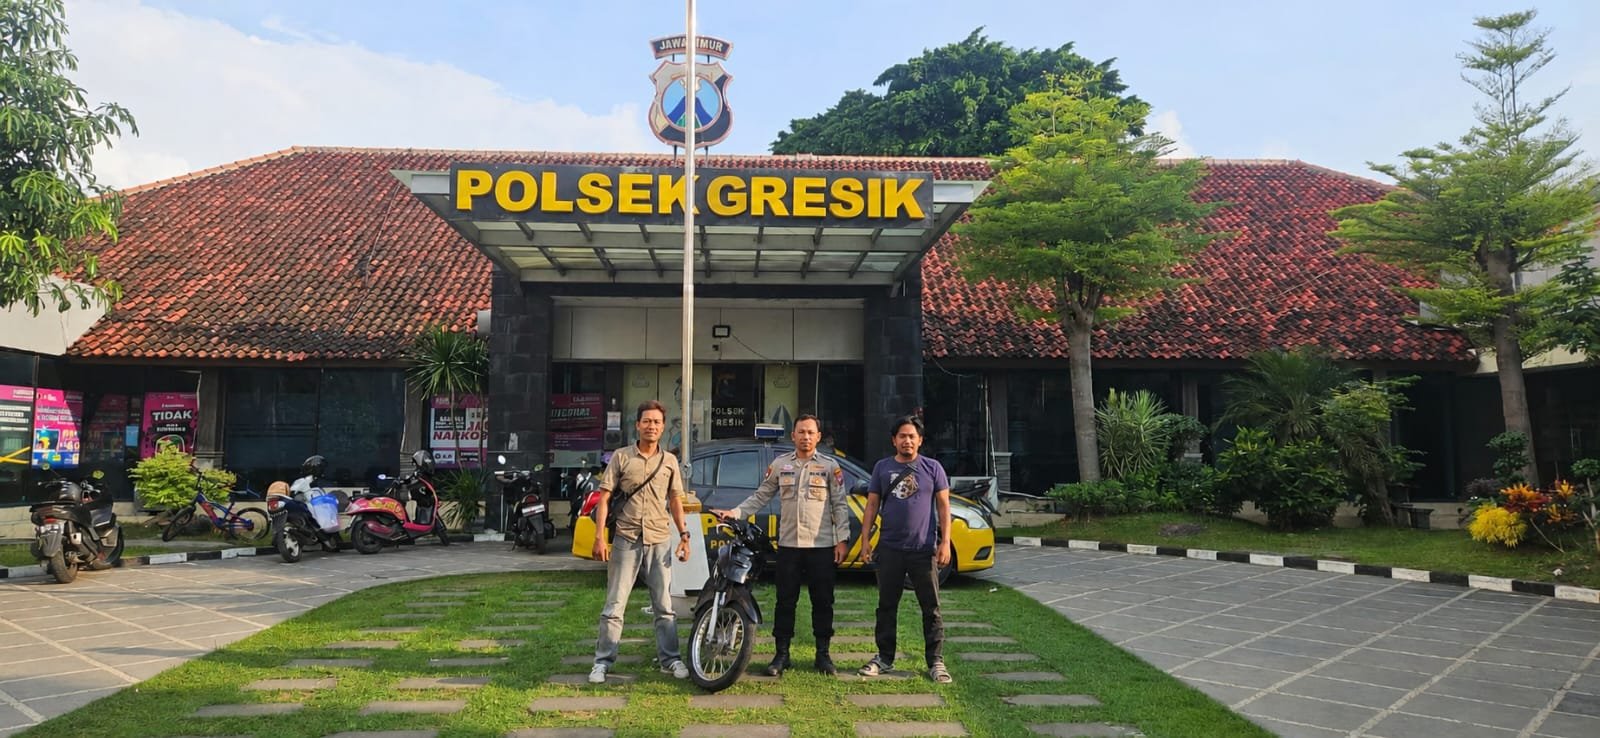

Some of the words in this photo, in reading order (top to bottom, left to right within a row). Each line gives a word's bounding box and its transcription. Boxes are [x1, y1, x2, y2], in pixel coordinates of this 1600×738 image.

[695, 38, 723, 51] IMUR
[456, 169, 700, 217] POLSEK
[705, 174, 927, 220] GRESIK
[151, 410, 193, 421] TIDAK
[711, 418, 745, 427] RESIK
